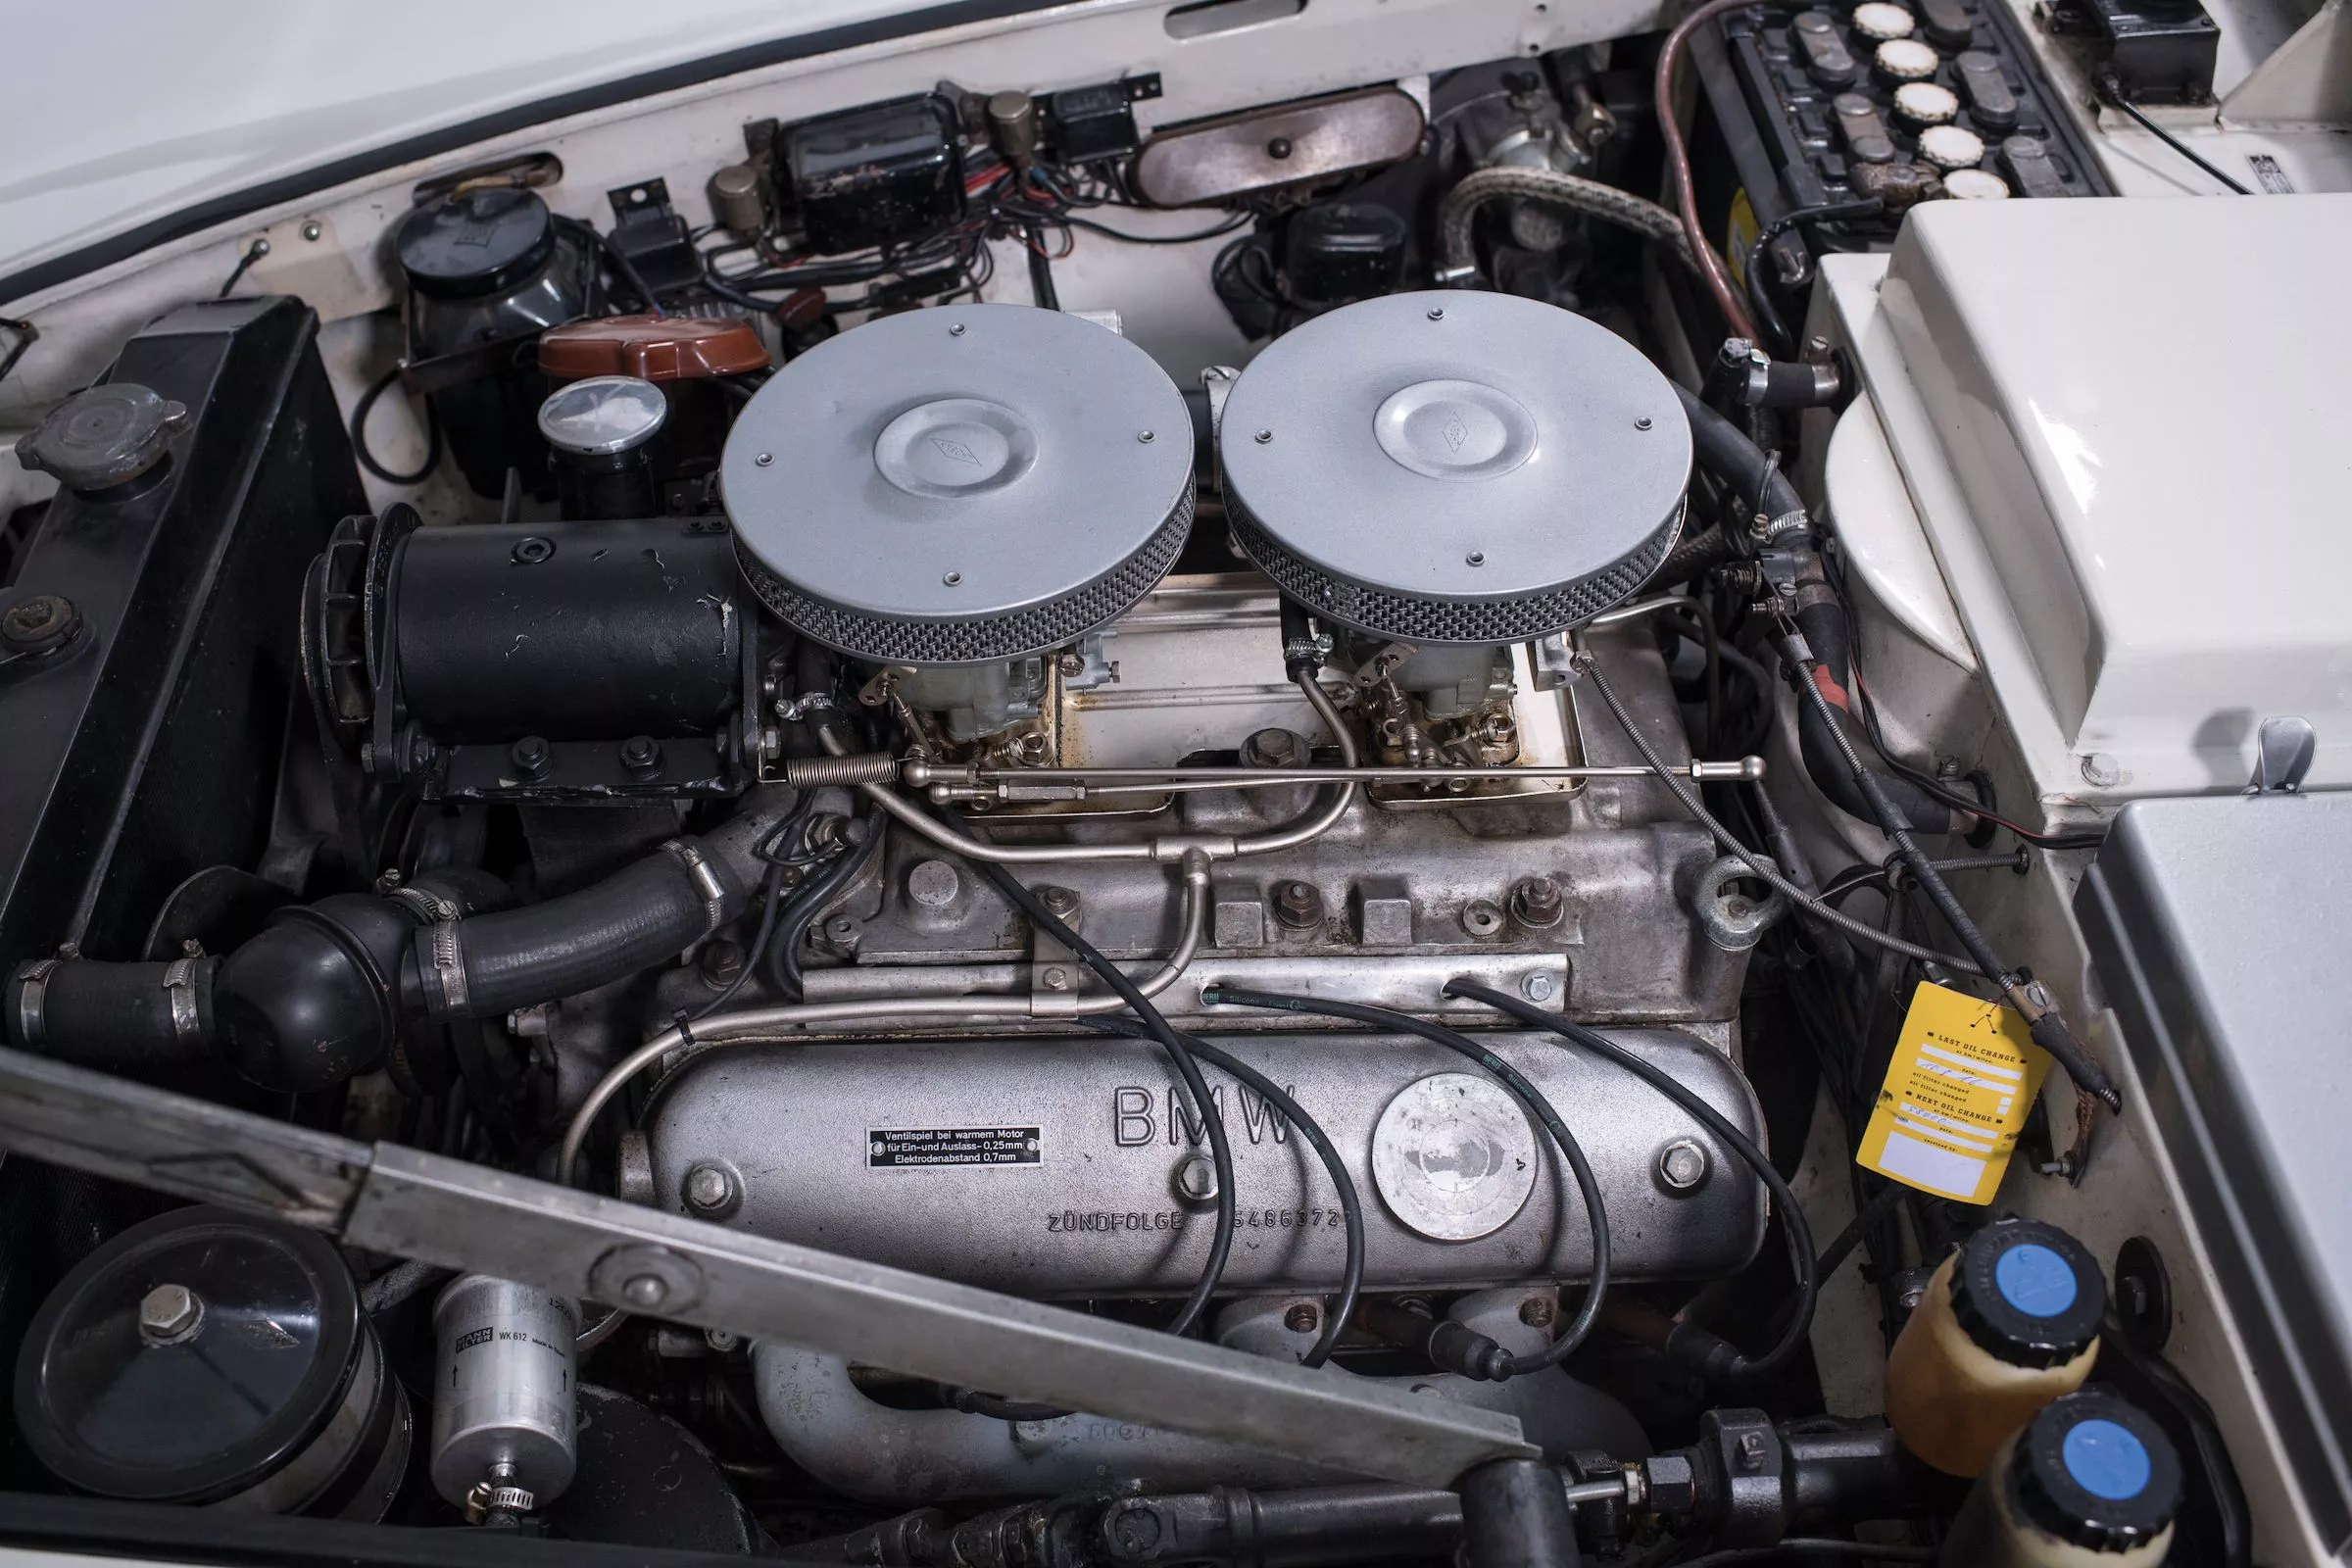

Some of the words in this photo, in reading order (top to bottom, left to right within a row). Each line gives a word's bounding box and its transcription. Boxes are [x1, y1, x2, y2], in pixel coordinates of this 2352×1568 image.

[1938, 1035, 1961, 1047] LAST
[1963, 1042, 1978, 1053] OIL
[1981, 1048, 2015, 1062] CHANGE
[1506, 1073, 1532, 1099] Silicone
[1921, 1082, 1938, 1094] filter
[1939, 1090, 1966, 1102] changed
[1942, 1080, 1969, 1095] changed
[1114, 1085, 1296, 1148] BMW
[1916, 1094, 1938, 1106] NEXT
[1941, 1101, 1956, 1111] OIL
[1958, 1105, 1991, 1122] CHANGE
[885, 1132, 932, 1142] Ventilspiel
[886, 1143, 900, 1152] für
[983, 1141, 1022, 1151] 0,25mm
[896, 1153, 980, 1163] Elektrodenabstand
[983, 1152, 1016, 1162] 0,7mm
[1048, 1209, 1182, 1232] ZÜNDFOLGE
[499, 1331, 512, 1341] WK
[513, 1331, 527, 1341] 612
